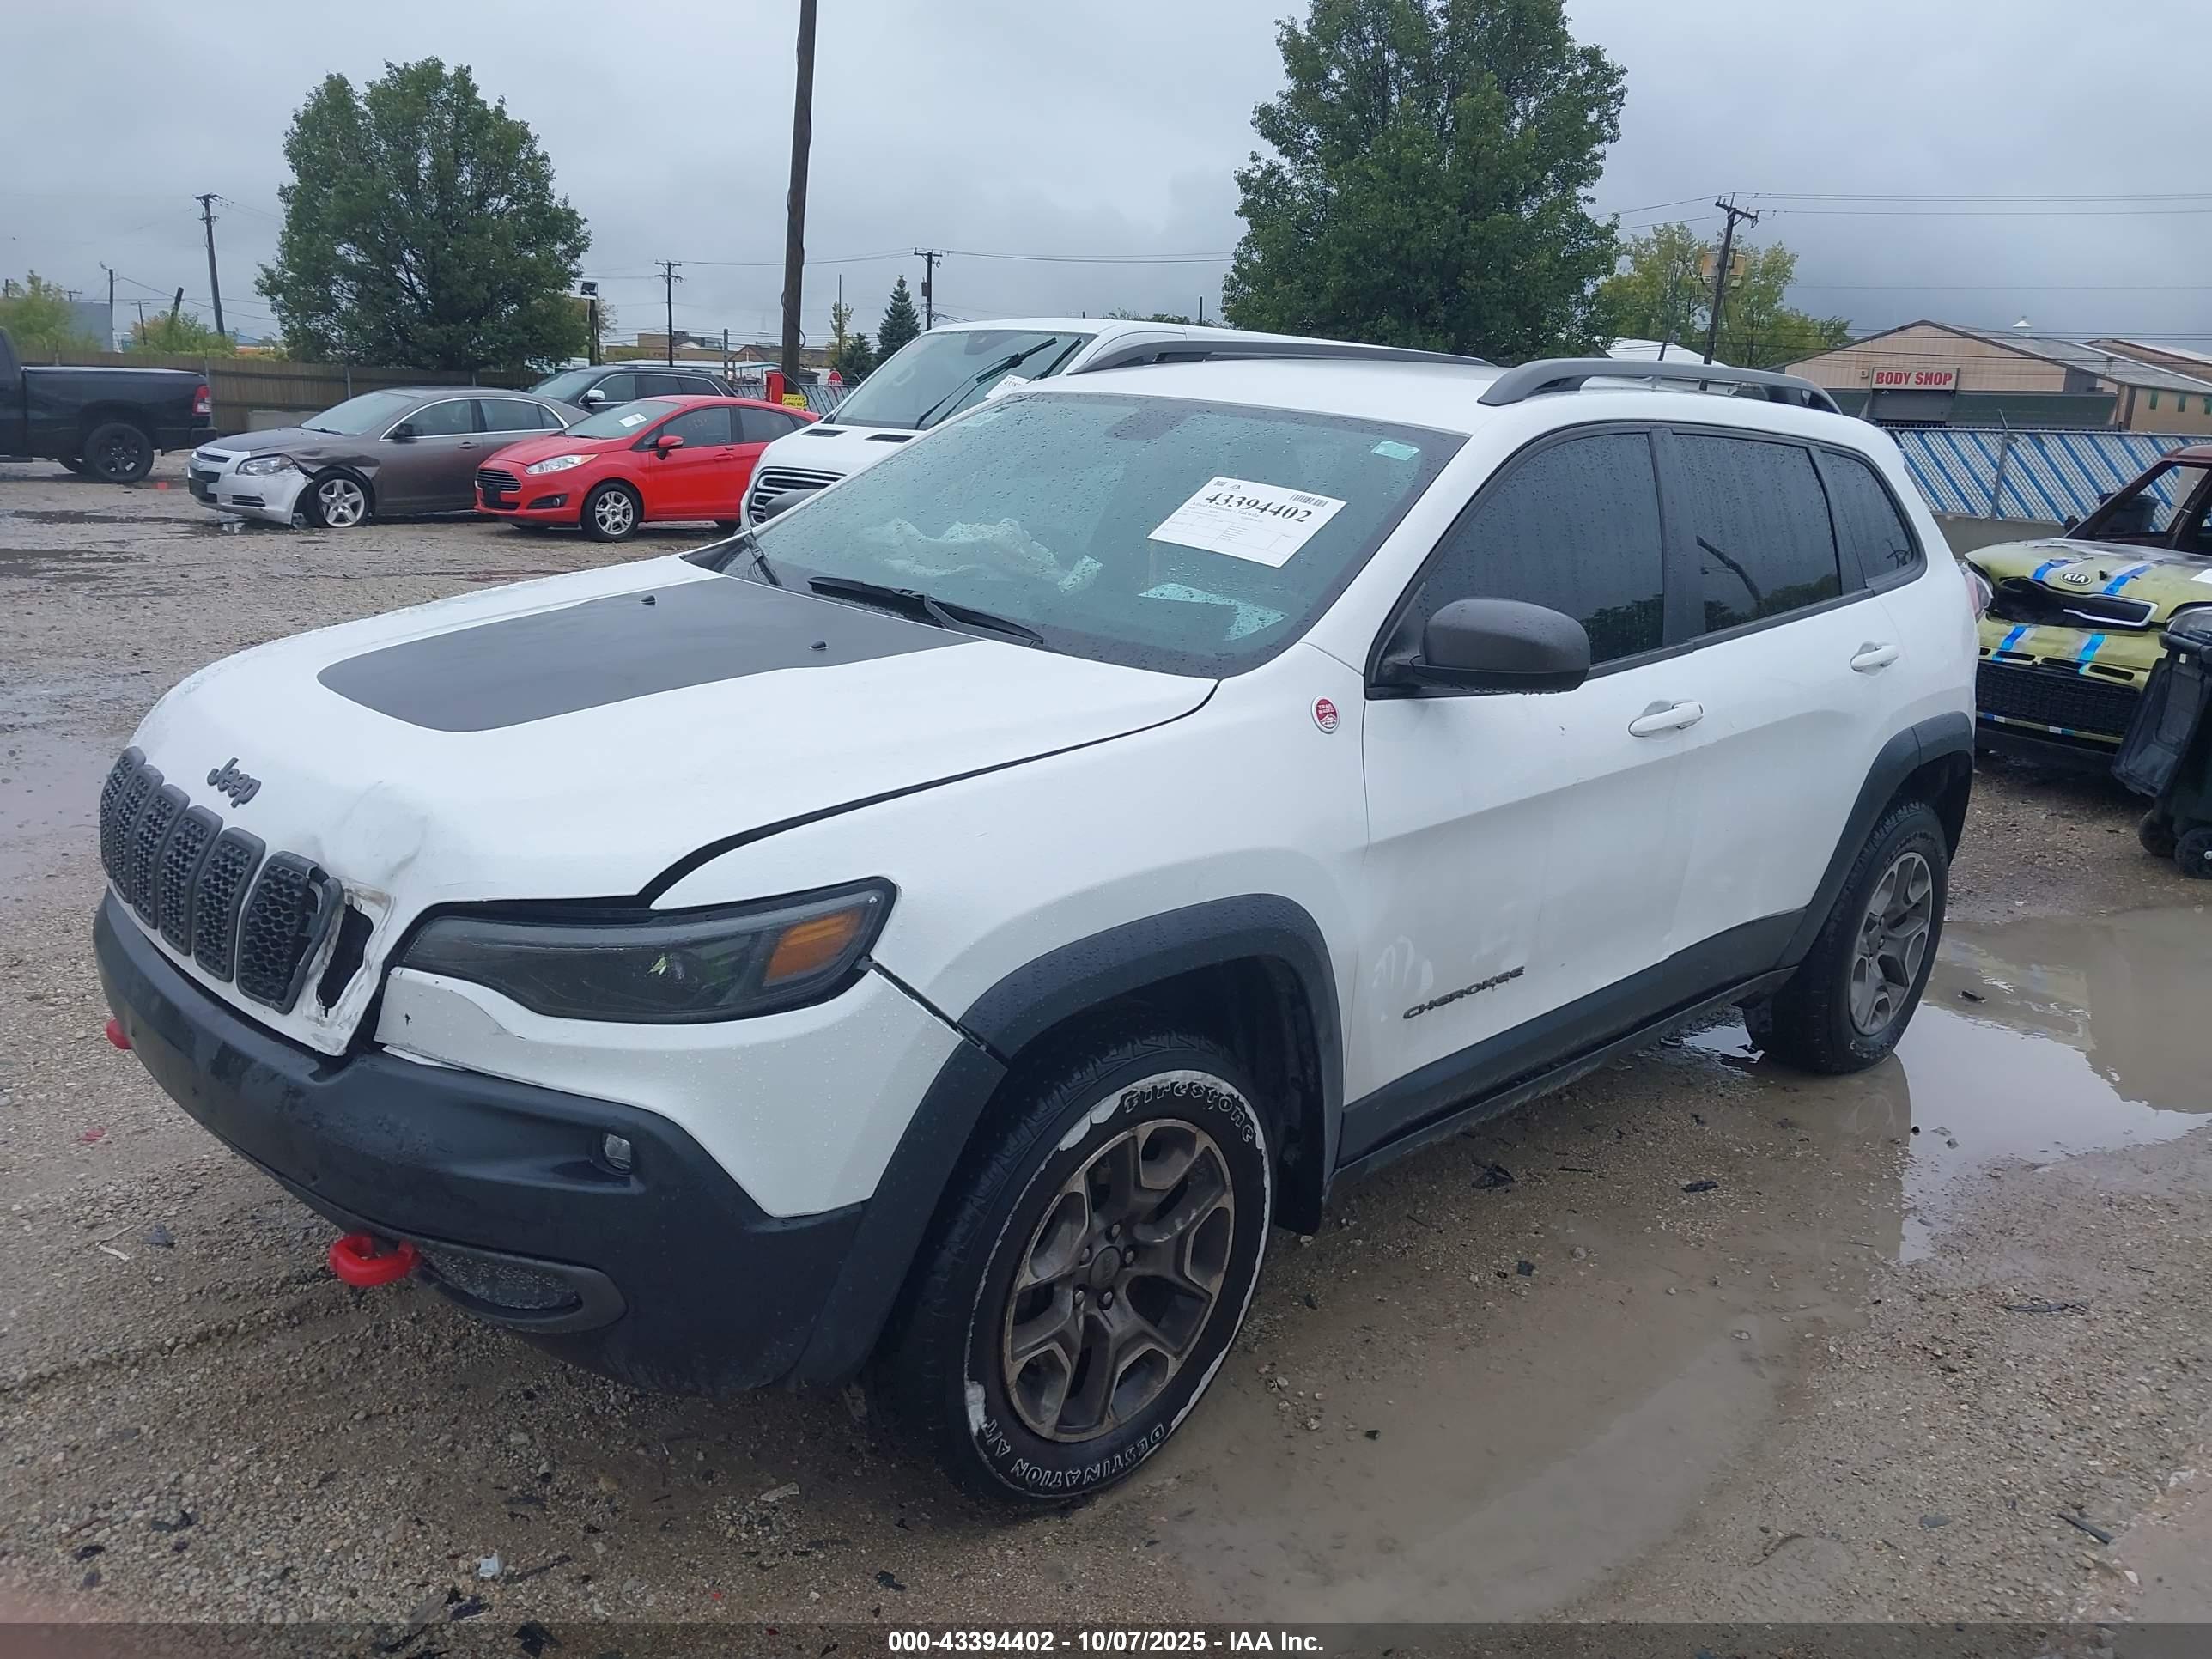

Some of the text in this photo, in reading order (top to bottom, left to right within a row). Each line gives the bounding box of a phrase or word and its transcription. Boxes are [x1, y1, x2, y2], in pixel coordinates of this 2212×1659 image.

[1875, 372, 1953, 386] BODY SHOP
[1205, 492, 1313, 523] 43394402
[2063, 573, 2086, 583] KIA
[207, 757, 262, 808] Jeep
[1403, 965, 1525, 1019] CHEROKEE
[1123, 1081, 1255, 1143] Firestone
[1010, 1423, 1165, 1487] DESTINATION
